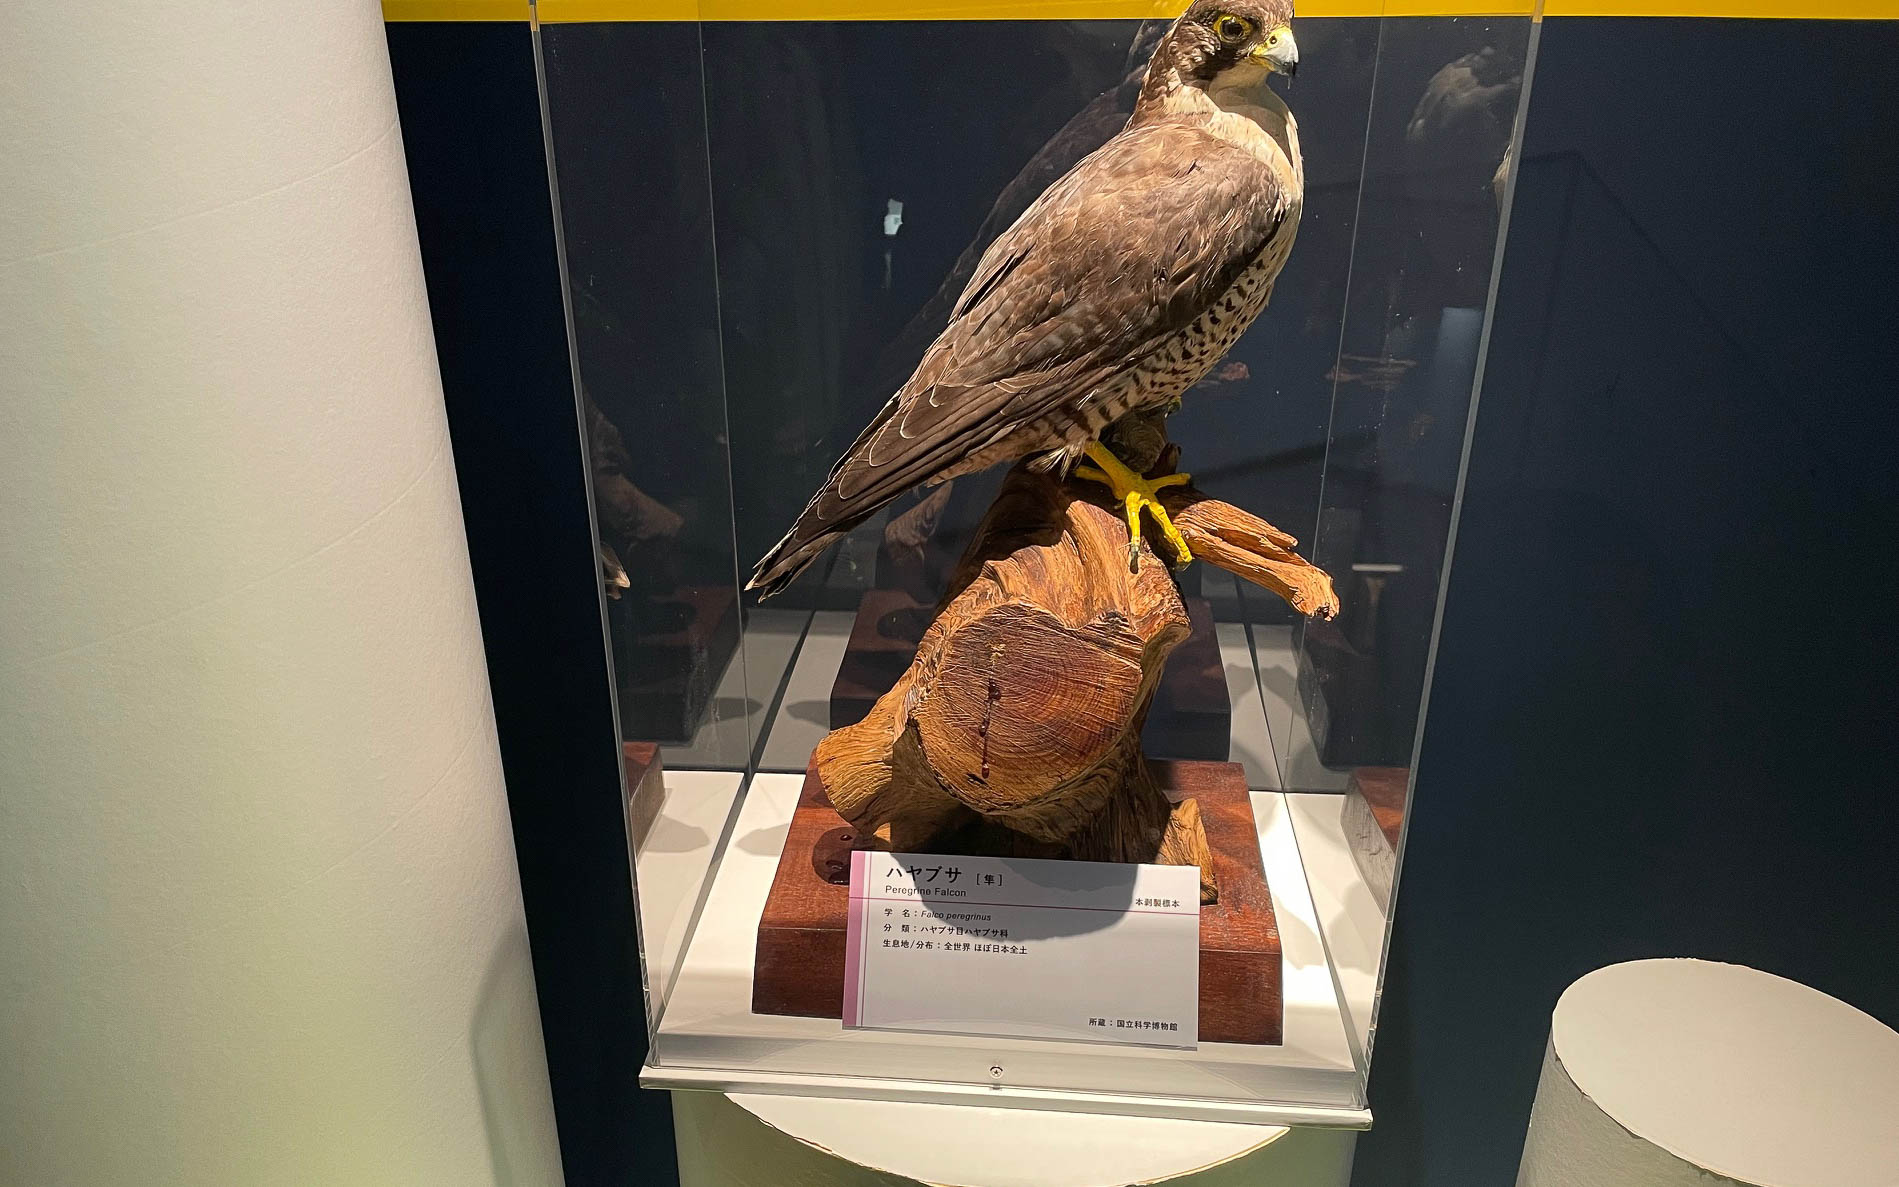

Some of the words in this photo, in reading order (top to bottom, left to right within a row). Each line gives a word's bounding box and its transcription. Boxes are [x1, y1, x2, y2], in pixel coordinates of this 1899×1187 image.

[886, 865, 962, 883] ハヤブサ
[885, 885, 931, 896] Peregrine
[934, 887, 967, 897] Falcon
[920, 910, 944, 919] Falco
[946, 912, 992, 921] peregrinus
